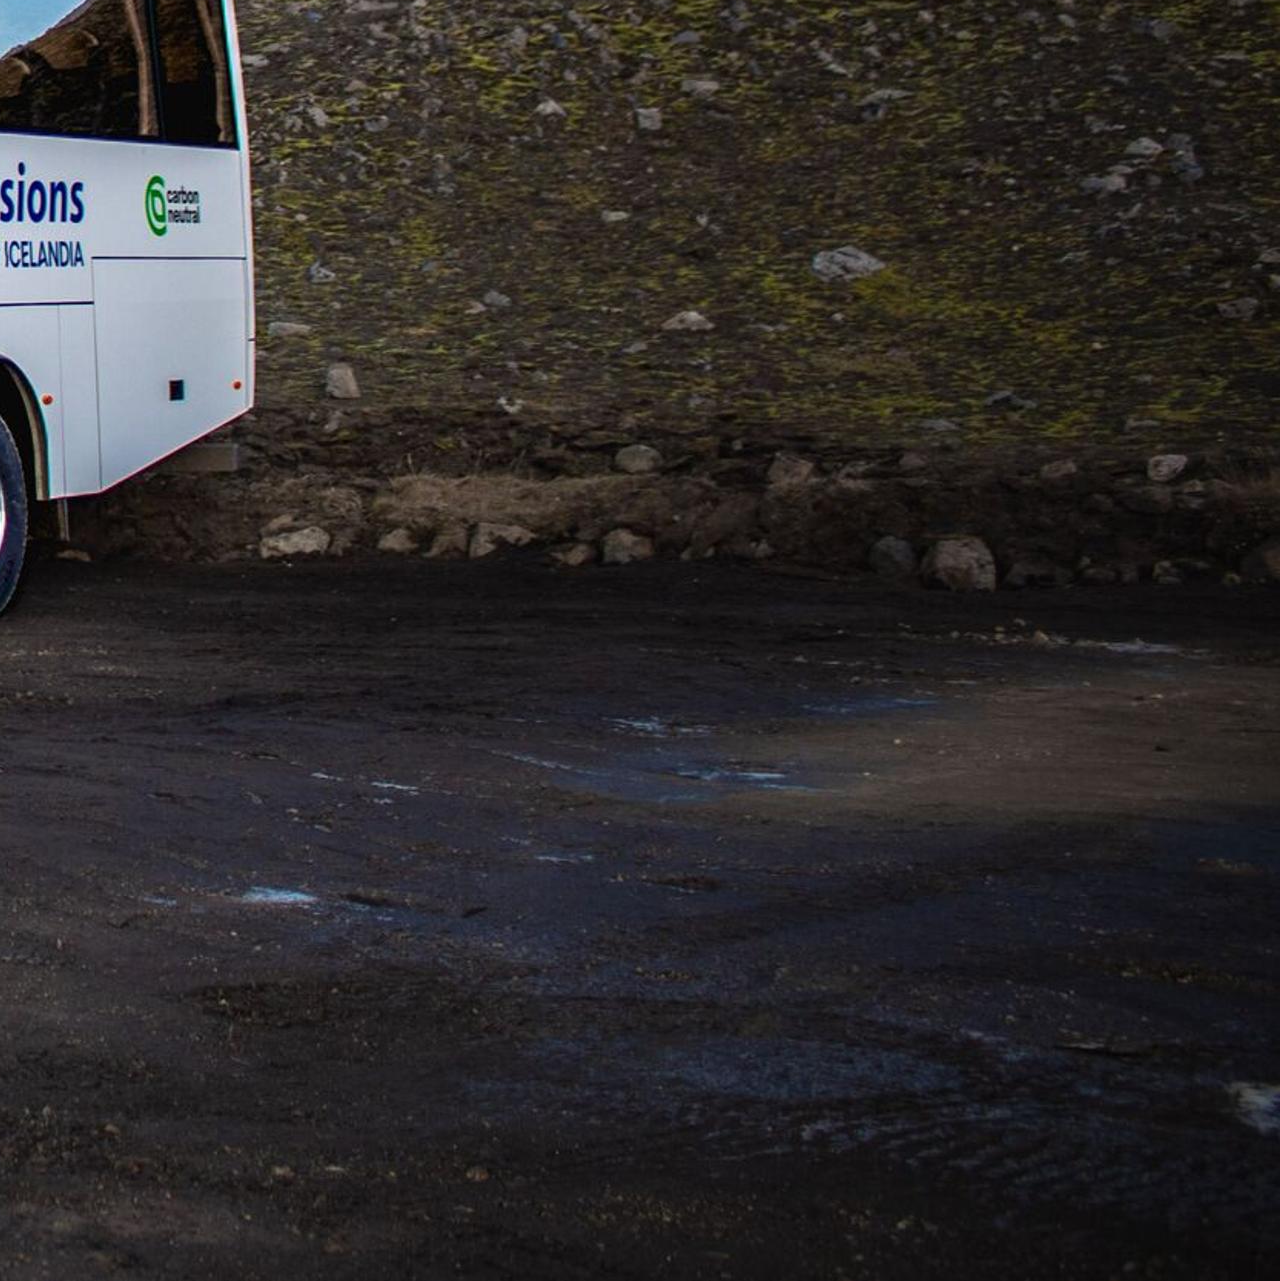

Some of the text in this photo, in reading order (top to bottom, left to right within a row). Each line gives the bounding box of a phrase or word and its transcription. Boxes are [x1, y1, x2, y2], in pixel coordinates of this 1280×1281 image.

[166, 185, 200, 204] carbon
[167, 206, 201, 224] neutral
[4, 240, 85, 269] ICELANDIA
